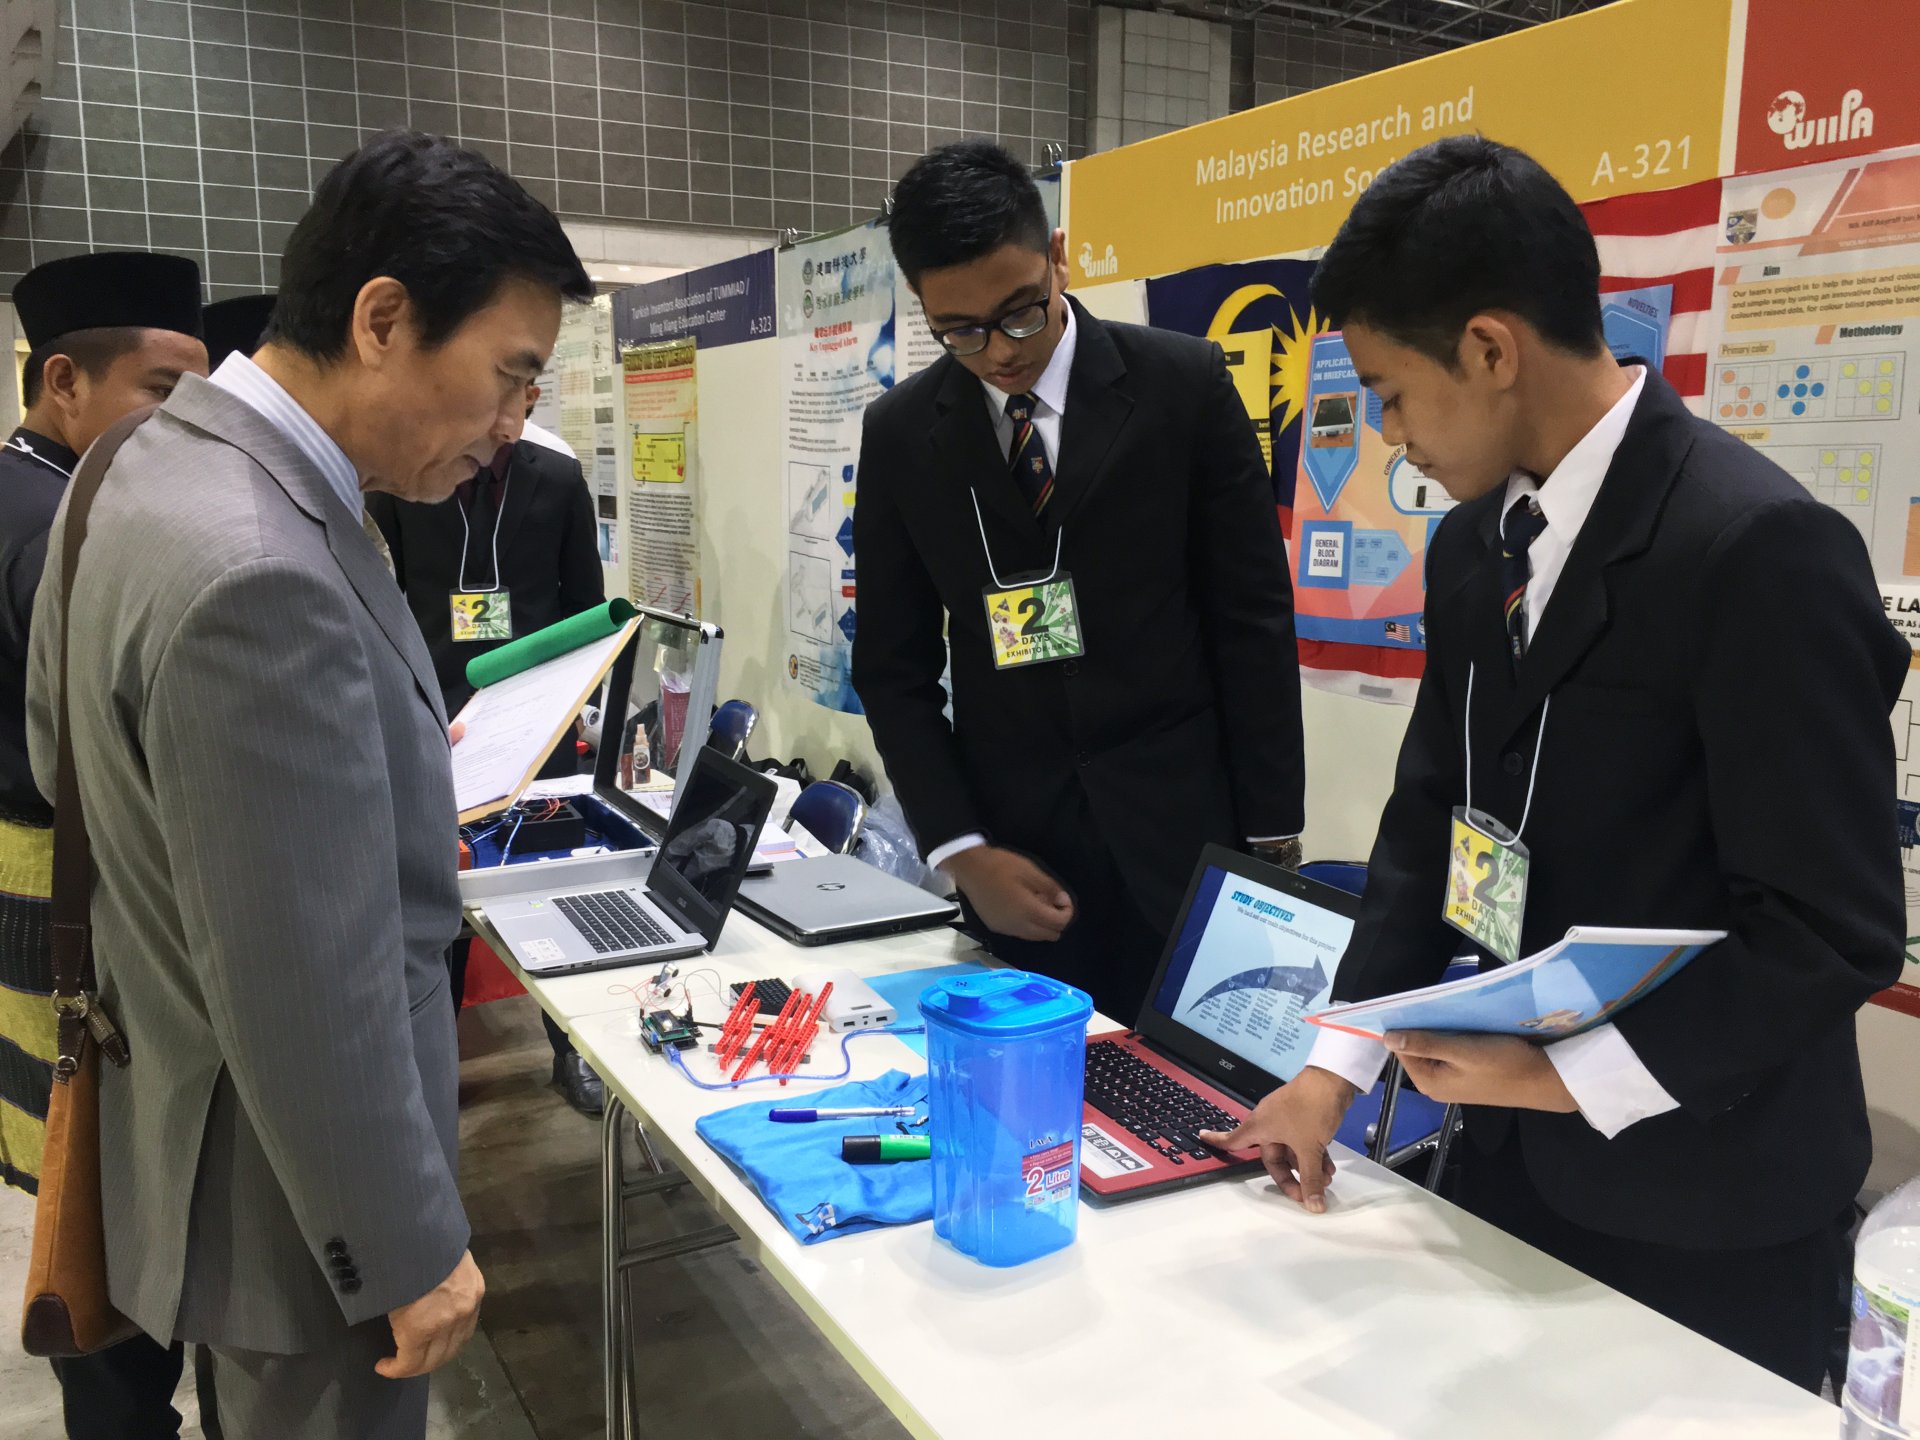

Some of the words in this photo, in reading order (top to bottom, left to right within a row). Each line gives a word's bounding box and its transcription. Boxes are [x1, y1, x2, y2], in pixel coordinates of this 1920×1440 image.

[1196, 140, 1288, 186] Malaysia
[1298, 105, 1410, 161] Research
[1421, 85, 1474, 131] and
[1591, 135, 1691, 187] A-321
[1216, 177, 1334, 224] Innovation
[1343, 157, 1396, 198] So
[1763, 266, 1780, 277] Aim
[1733, 290, 1746, 298] Our
[1749, 288, 1772, 297] team's
[1774, 285, 1801, 294] project
[1856, 276, 1876, 285] blind
[1878, 274, 1894, 282] and
[674, 293, 705, 310] Association
[706, 287, 713, 302] of
[1628, 297, 1659, 318] NOVELTIES
[1731, 311, 1762, 319] coloured
[1819, 303, 1844, 312] colour
[1866, 299, 1893, 308] people
[678, 313, 705, 329] Education
[706, 309, 726, 323] Center
[750, 316, 772, 335] A-323
[1840, 325, 1903, 338] Methodology
[1313, 372, 1322, 381] ON
[1384, 445, 1405, 476] CONCEPT
[1315, 539, 1339, 549] GENERAL
[1318, 549, 1335, 558] BLOCK
[1313, 559, 1339, 567] DIAGRAM
[472, 600, 491, 623] 2
[1018, 597, 1049, 636] 2
[1906, 620, 1916, 628] AS
[1022, 633, 1051, 645] DAYS
[1473, 851, 1499, 911] 2
[1231, 890, 1254, 906] STUDY
[1253, 899, 1296, 923] OBJECTIVES
[1471, 898, 1496, 924] DAYS
[1218, 1059, 1236, 1071] acer
[1027, 1167, 1044, 1196] 2
[1046, 1169, 1071, 1188] Litre
